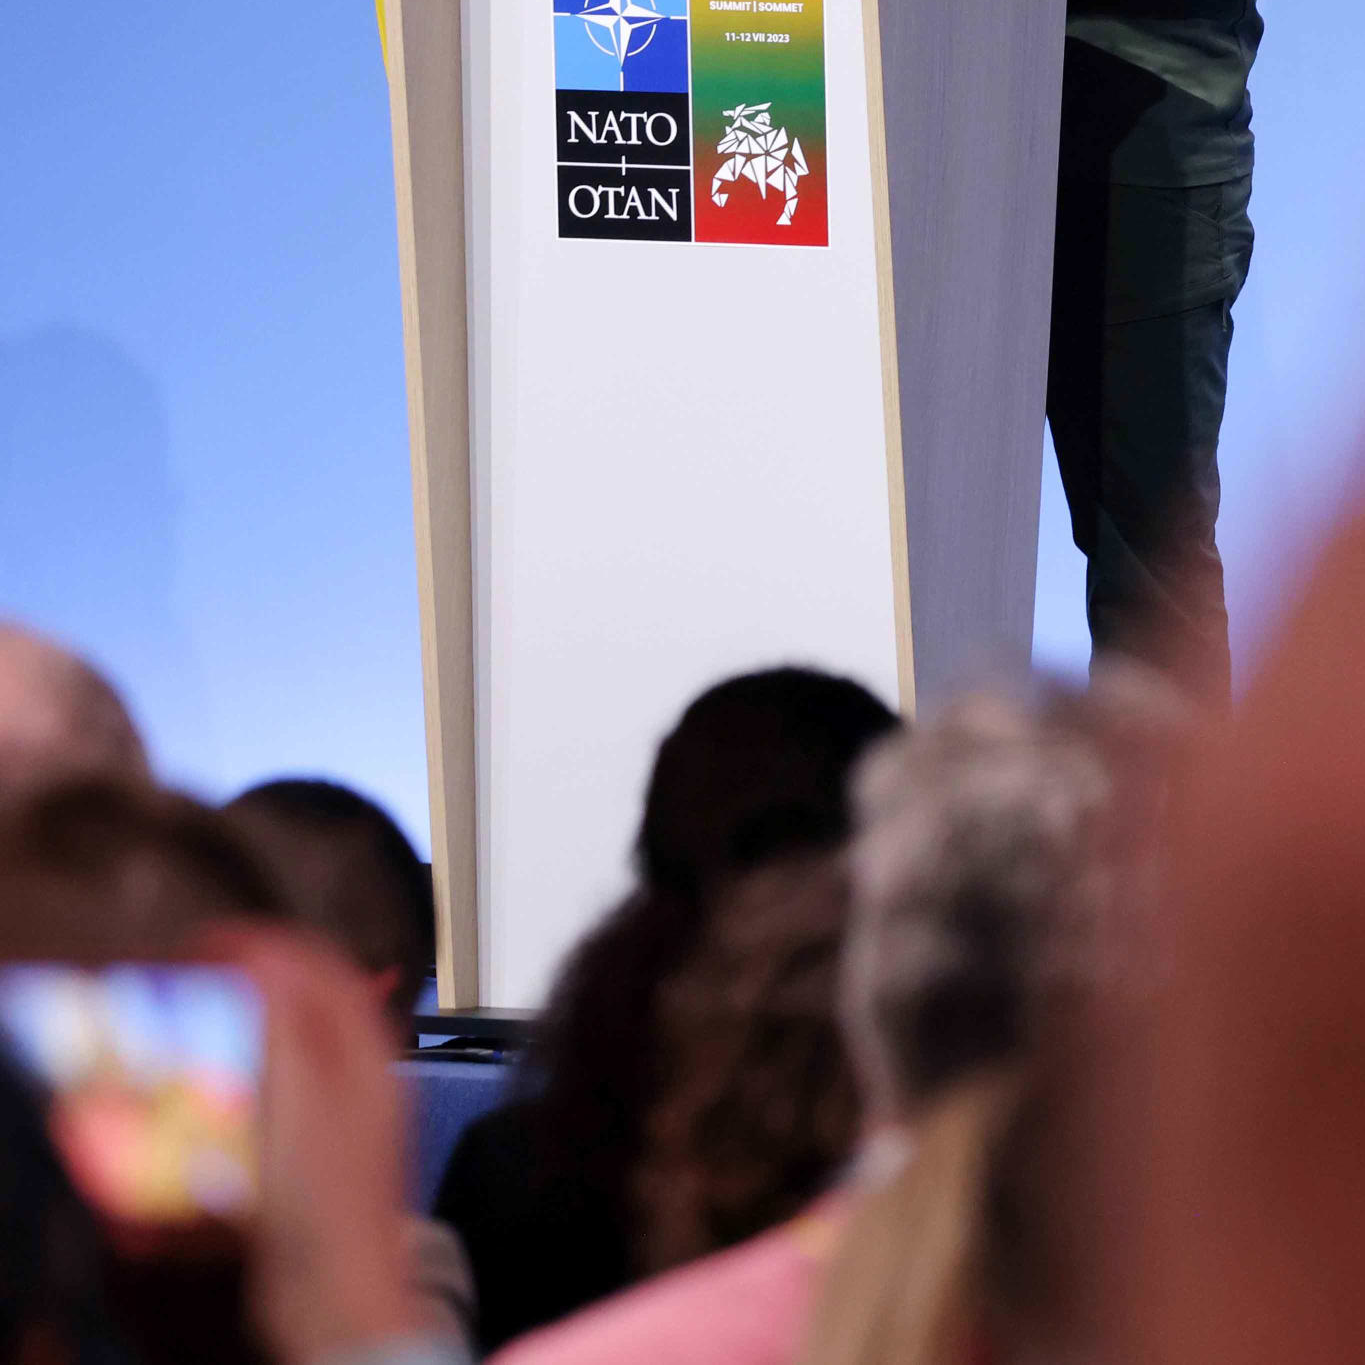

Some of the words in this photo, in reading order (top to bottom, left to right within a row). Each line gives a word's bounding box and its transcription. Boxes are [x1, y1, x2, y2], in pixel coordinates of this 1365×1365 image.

[709, 0, 751, 12] SUMMIT
[758, 2, 803, 13] SOMMET
[725, 32, 751, 42] 11-12
[752, 33, 765, 42] VII
[767, 33, 790, 43] 2023
[567, 110, 677, 146] NATO
[568, 185, 680, 221] OTAN
